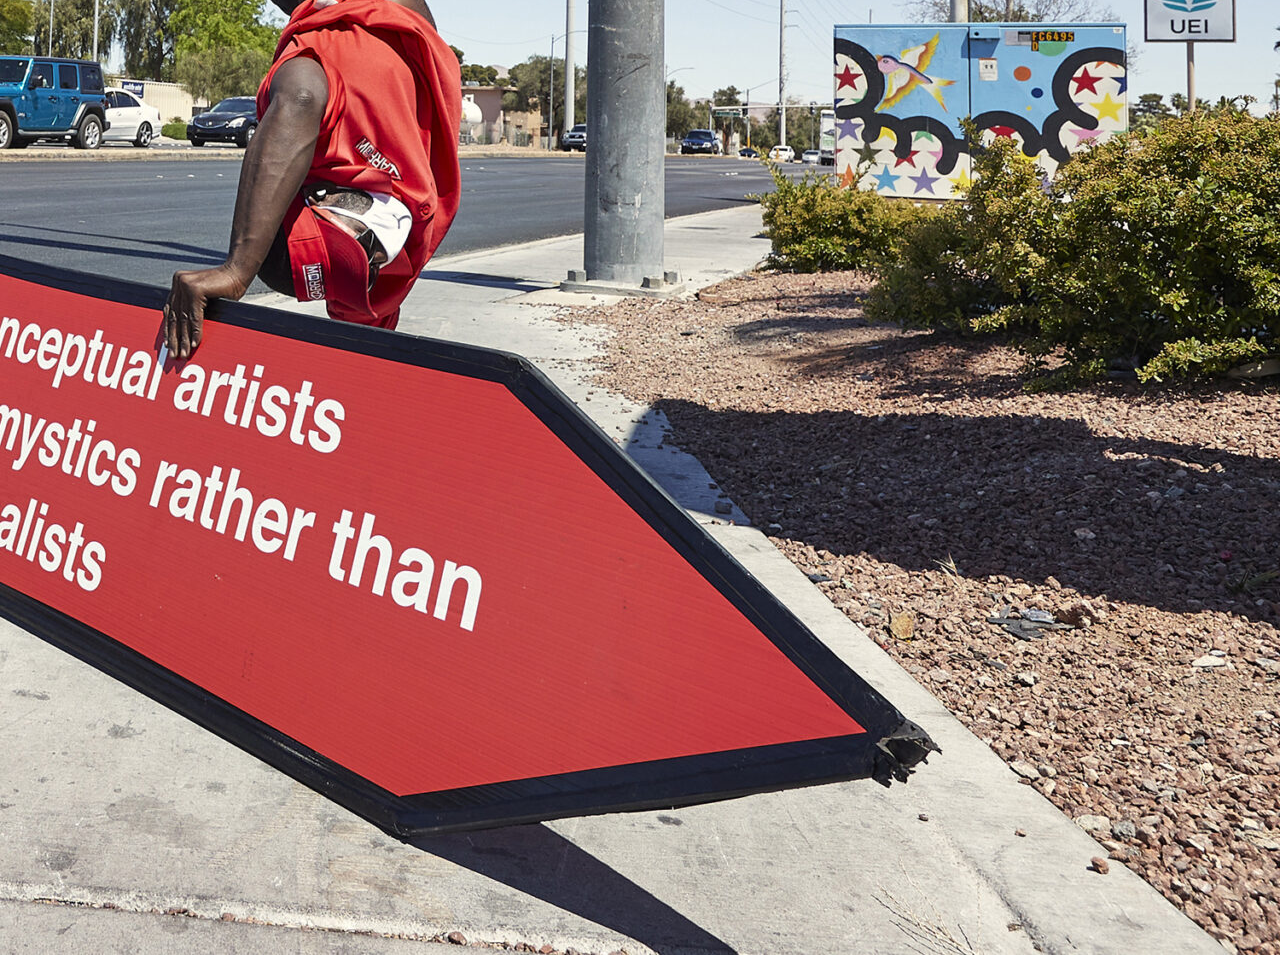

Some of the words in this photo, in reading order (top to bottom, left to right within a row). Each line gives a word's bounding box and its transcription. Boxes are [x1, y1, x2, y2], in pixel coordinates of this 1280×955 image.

[1031, 31, 1074, 42] FC6495
[1170, 19, 1209, 34] UEI
[173, 363, 346, 454] artists
[149, 460, 317, 562] rather
[328, 509, 483, 632] than
